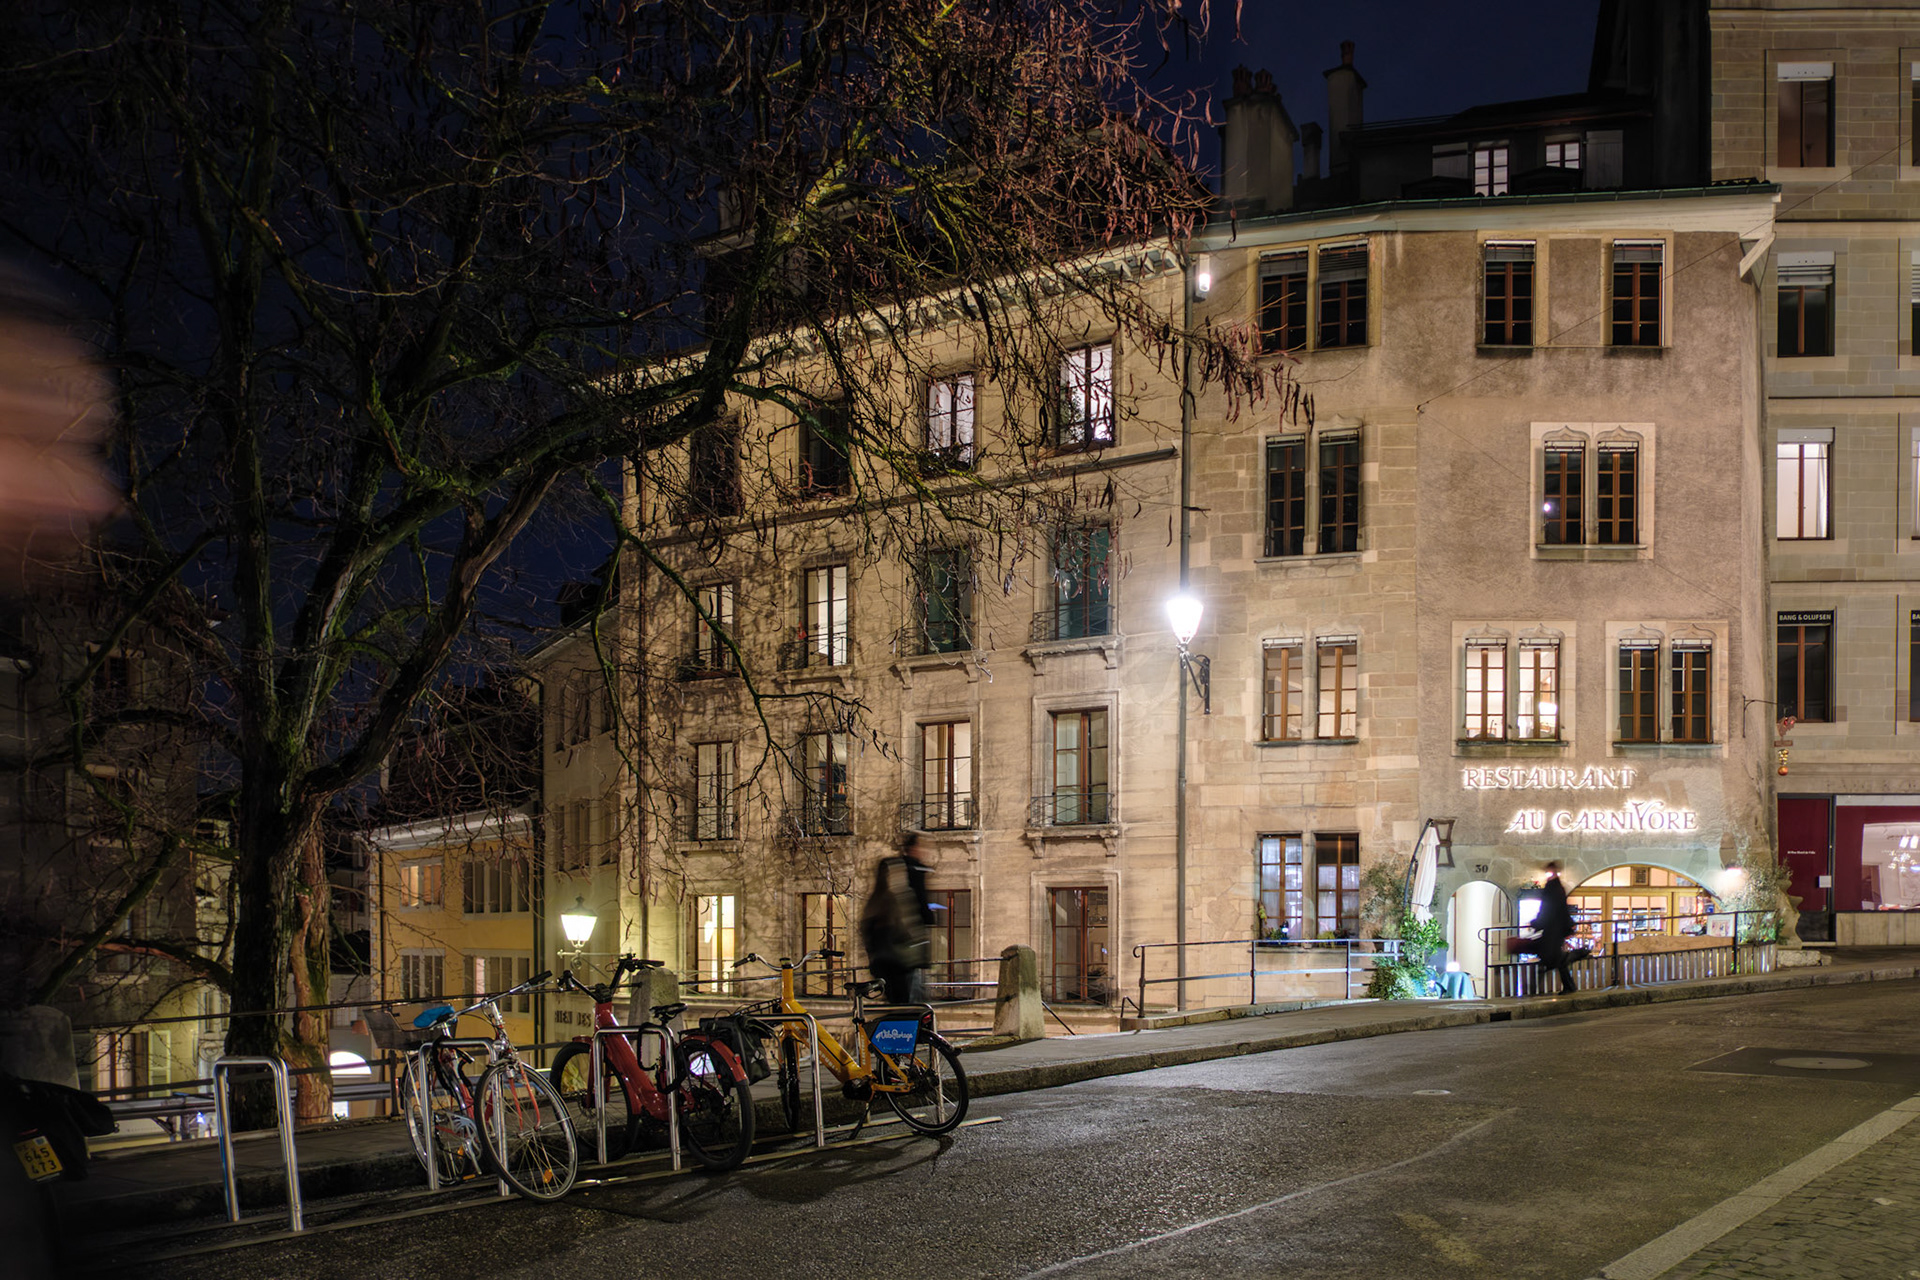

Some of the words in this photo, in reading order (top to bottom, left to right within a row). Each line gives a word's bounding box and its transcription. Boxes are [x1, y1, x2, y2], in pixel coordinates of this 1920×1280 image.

[1779, 613, 1797, 621] BANG
[1463, 766, 1637, 789] RESTAURANT
[1504, 810, 1545, 833] AU
[1554, 799, 1699, 832] CARNIVORE
[1474, 864, 1489, 874] 30
